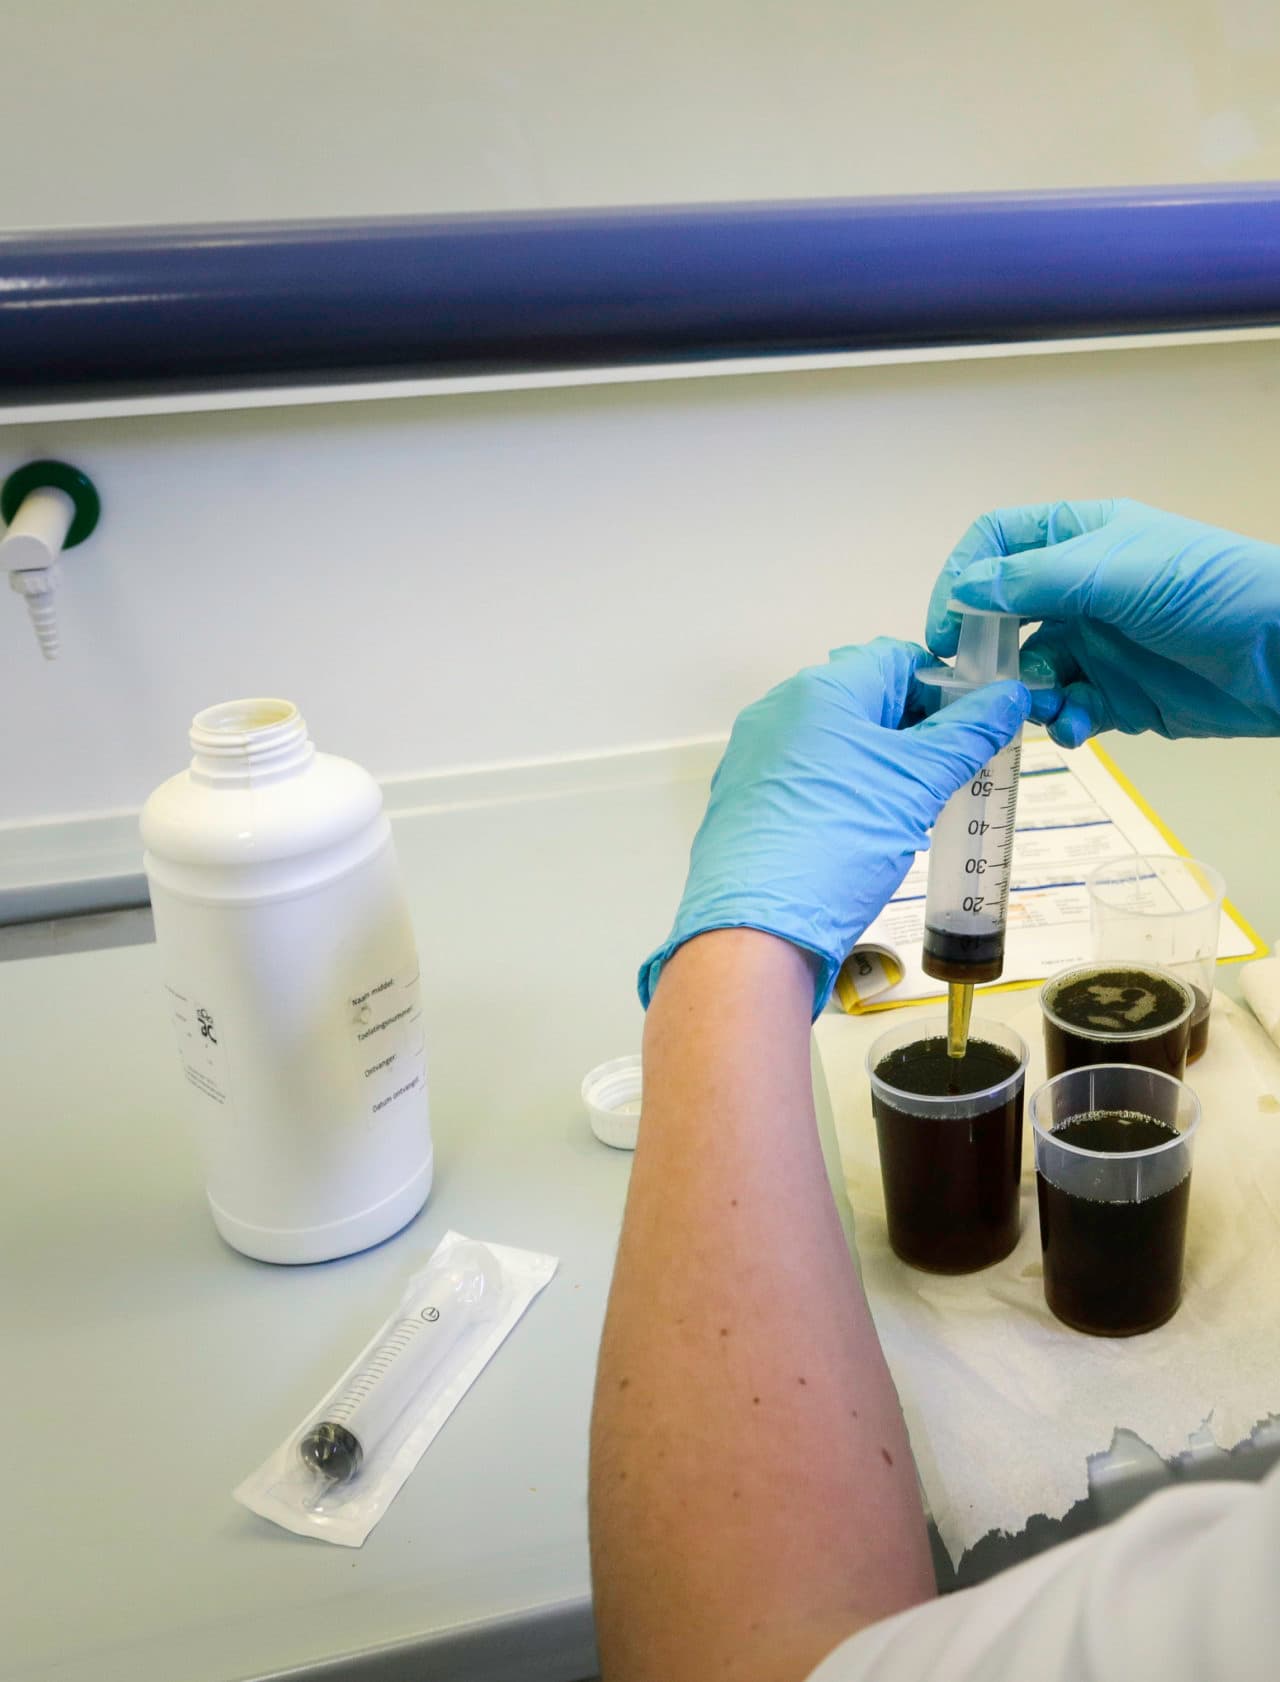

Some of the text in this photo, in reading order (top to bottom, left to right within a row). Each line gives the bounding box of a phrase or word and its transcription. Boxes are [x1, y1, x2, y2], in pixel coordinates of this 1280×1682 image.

[971, 780, 994, 797] 50
[967, 819, 990, 836] 40
[965, 858, 987, 874] 30
[962, 896, 985, 912] 20
